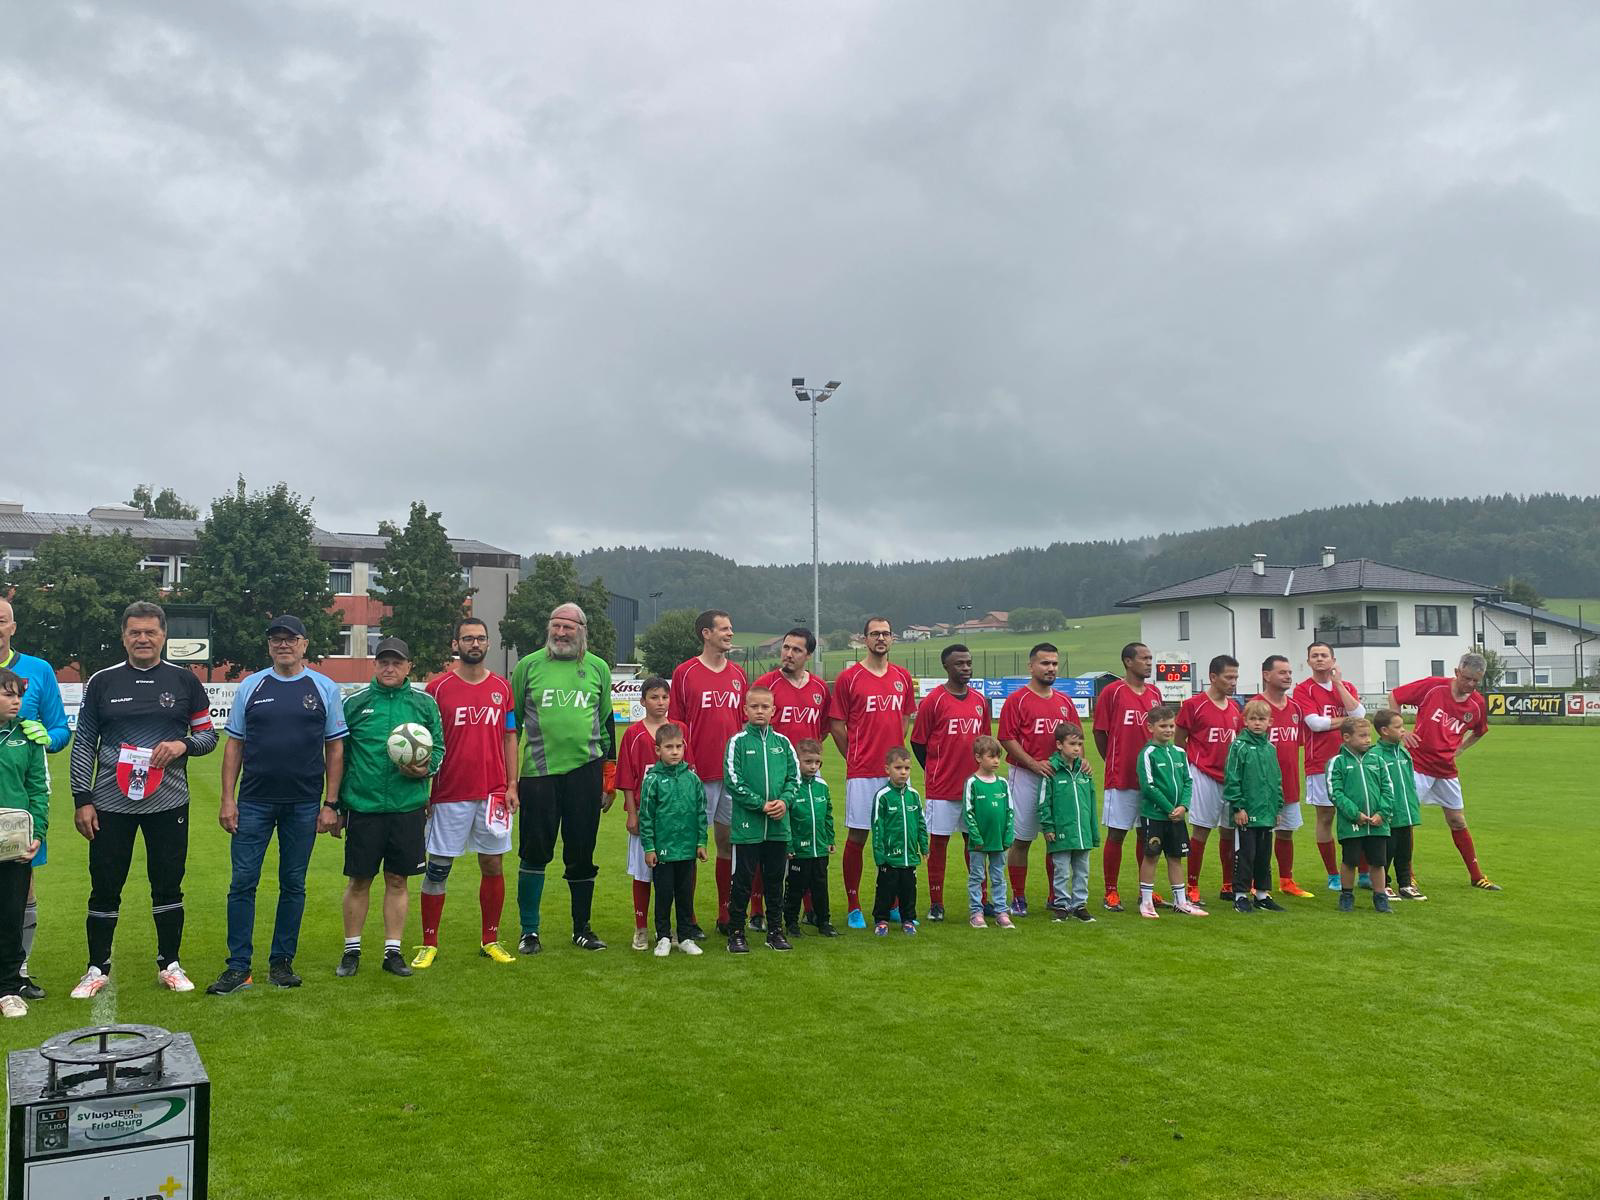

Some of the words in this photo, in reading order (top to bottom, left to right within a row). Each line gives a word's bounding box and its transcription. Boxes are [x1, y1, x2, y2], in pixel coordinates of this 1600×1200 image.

[1160, 664, 1166, 672] 0
[1181, 664, 1188, 672] 0
[1167, 673, 1180, 681] 00
[611, 680, 642, 693] Kase
[541, 689, 592, 709] EVN
[701, 691, 741, 709] EVN
[866, 695, 903, 712] EVN
[1505, 695, 1562, 712] CARPUTT
[454, 706, 501, 727] EVN
[780, 706, 820, 724] EVN
[1123, 709, 1149, 726] EV
[1430, 708, 1466, 734] EVN
[948, 718, 982, 735] EVN
[1034, 718, 1064, 734] EV
[1269, 727, 1299, 742] EVN
[77, 1112, 91, 1121] SV
[91, 1119, 143, 1131] Friedburg
[49, 1122, 67, 1131] LIGA
